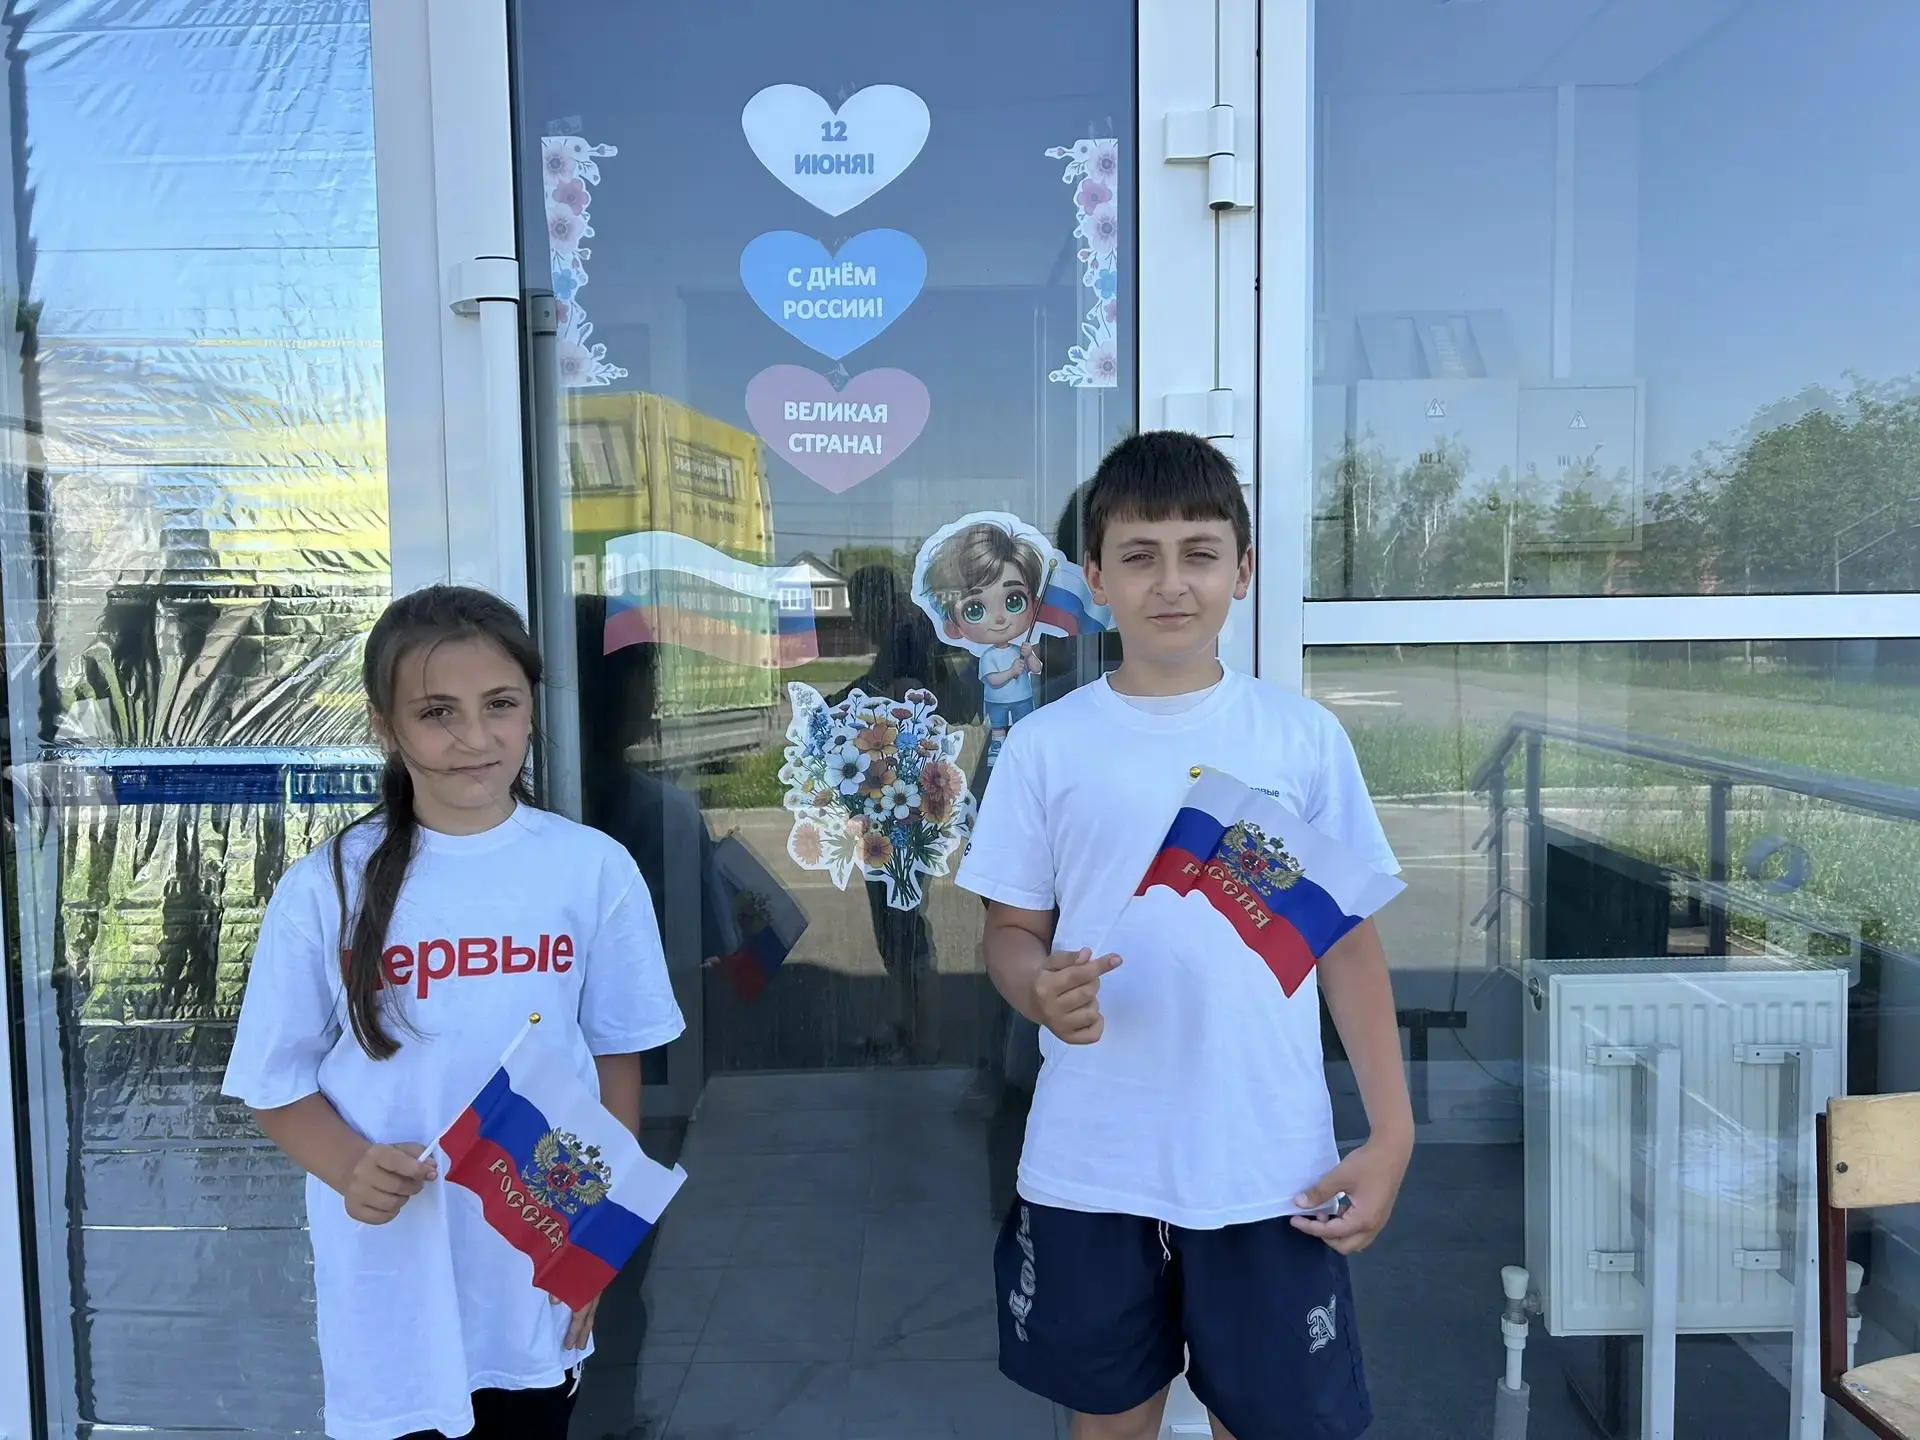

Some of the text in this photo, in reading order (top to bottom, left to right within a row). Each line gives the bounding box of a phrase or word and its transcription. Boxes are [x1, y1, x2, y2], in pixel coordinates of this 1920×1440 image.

[821, 121, 848, 142] 12
[794, 153, 875, 175] ИЮНЯ!
[787, 261, 876, 291] С ДНЁМ
[783, 297, 883, 320] РОССИИ!
[784, 400, 888, 424] ВЕЛИКАЯ
[788, 432, 882, 455] СТРАНА!
[1181, 861, 1272, 930] РССИЯ
[487, 1158, 564, 1253] РОССИЯ
